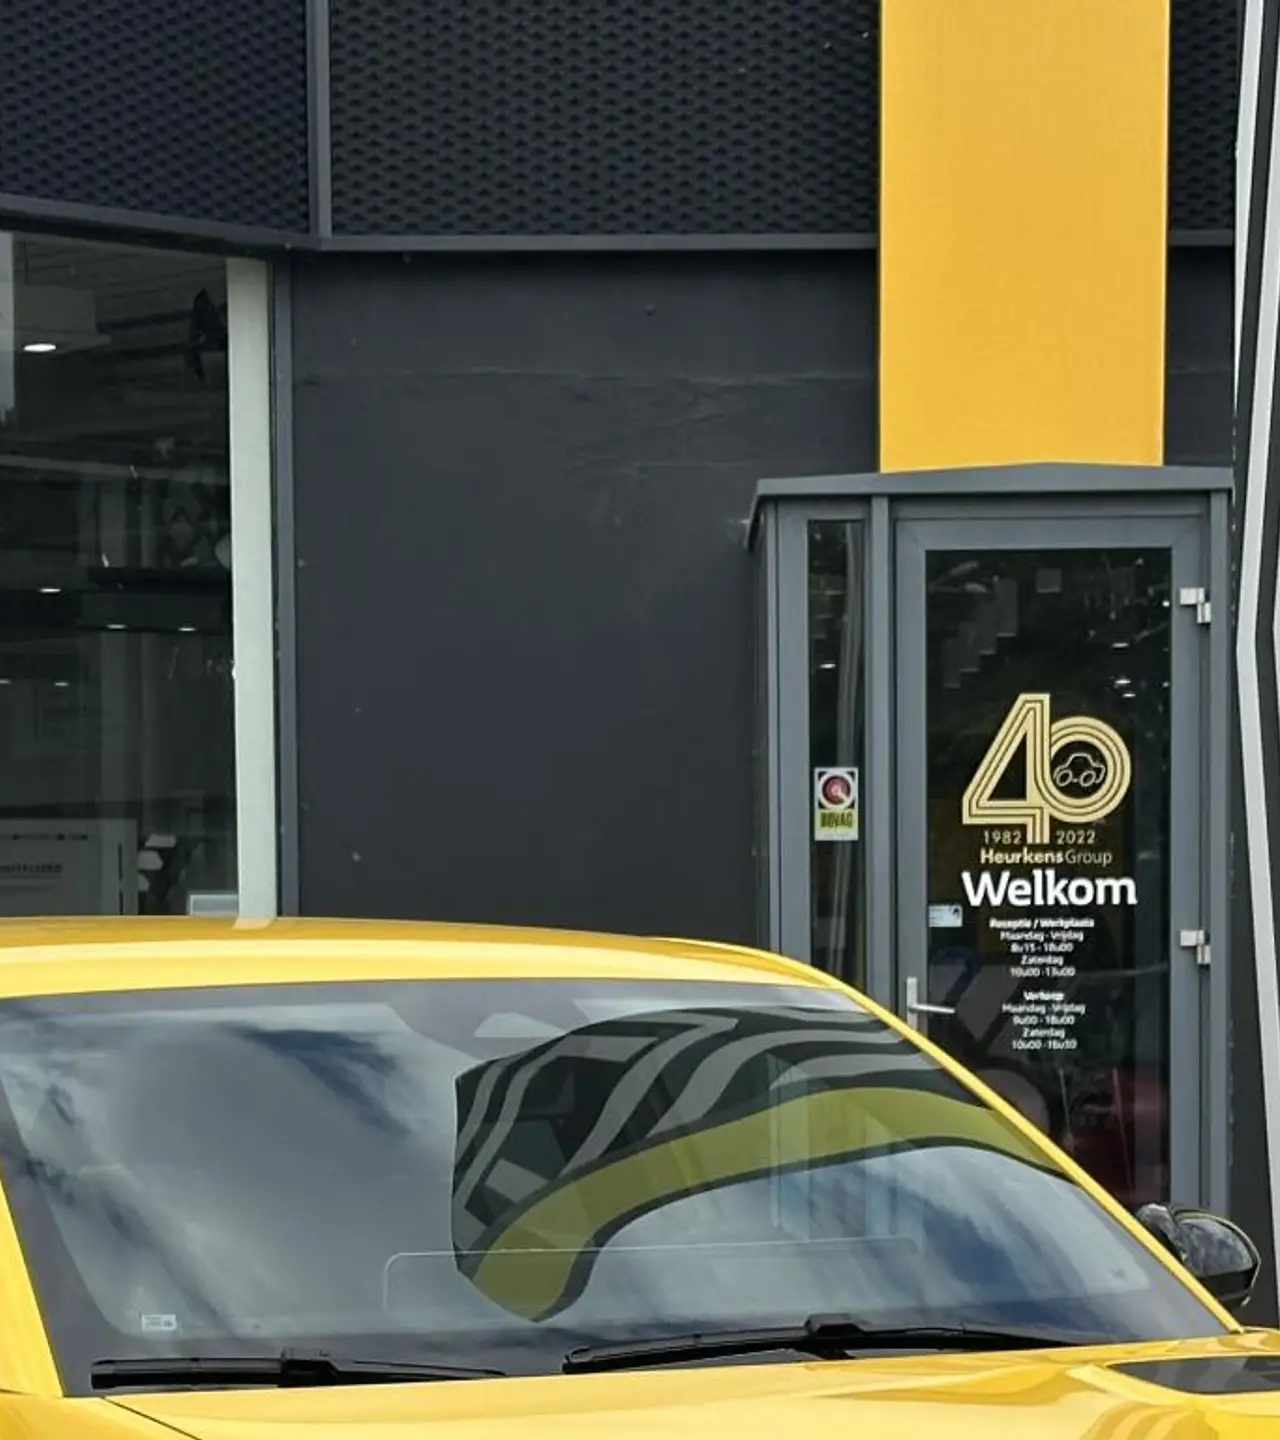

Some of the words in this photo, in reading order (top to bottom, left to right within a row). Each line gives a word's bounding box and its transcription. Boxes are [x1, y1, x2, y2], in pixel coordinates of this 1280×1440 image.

[962, 693, 1132, 844] 40
[984, 830, 1021, 844] 1982
[1056, 830, 1096, 844] 2022
[961, 868, 1138, 907] Welkom
[989, 917, 1032, 929] Receptie
[1000, 931, 1044, 942] Maandag
[1050, 930, 1084, 942] Vrijdag
[1021, 954, 1064, 966] Zaterdag
[1002, 1004, 1046, 1014] Maandag
[1051, 1004, 1086, 1015] Vrijdag
[1022, 1027, 1066, 1039] Zaterdag
